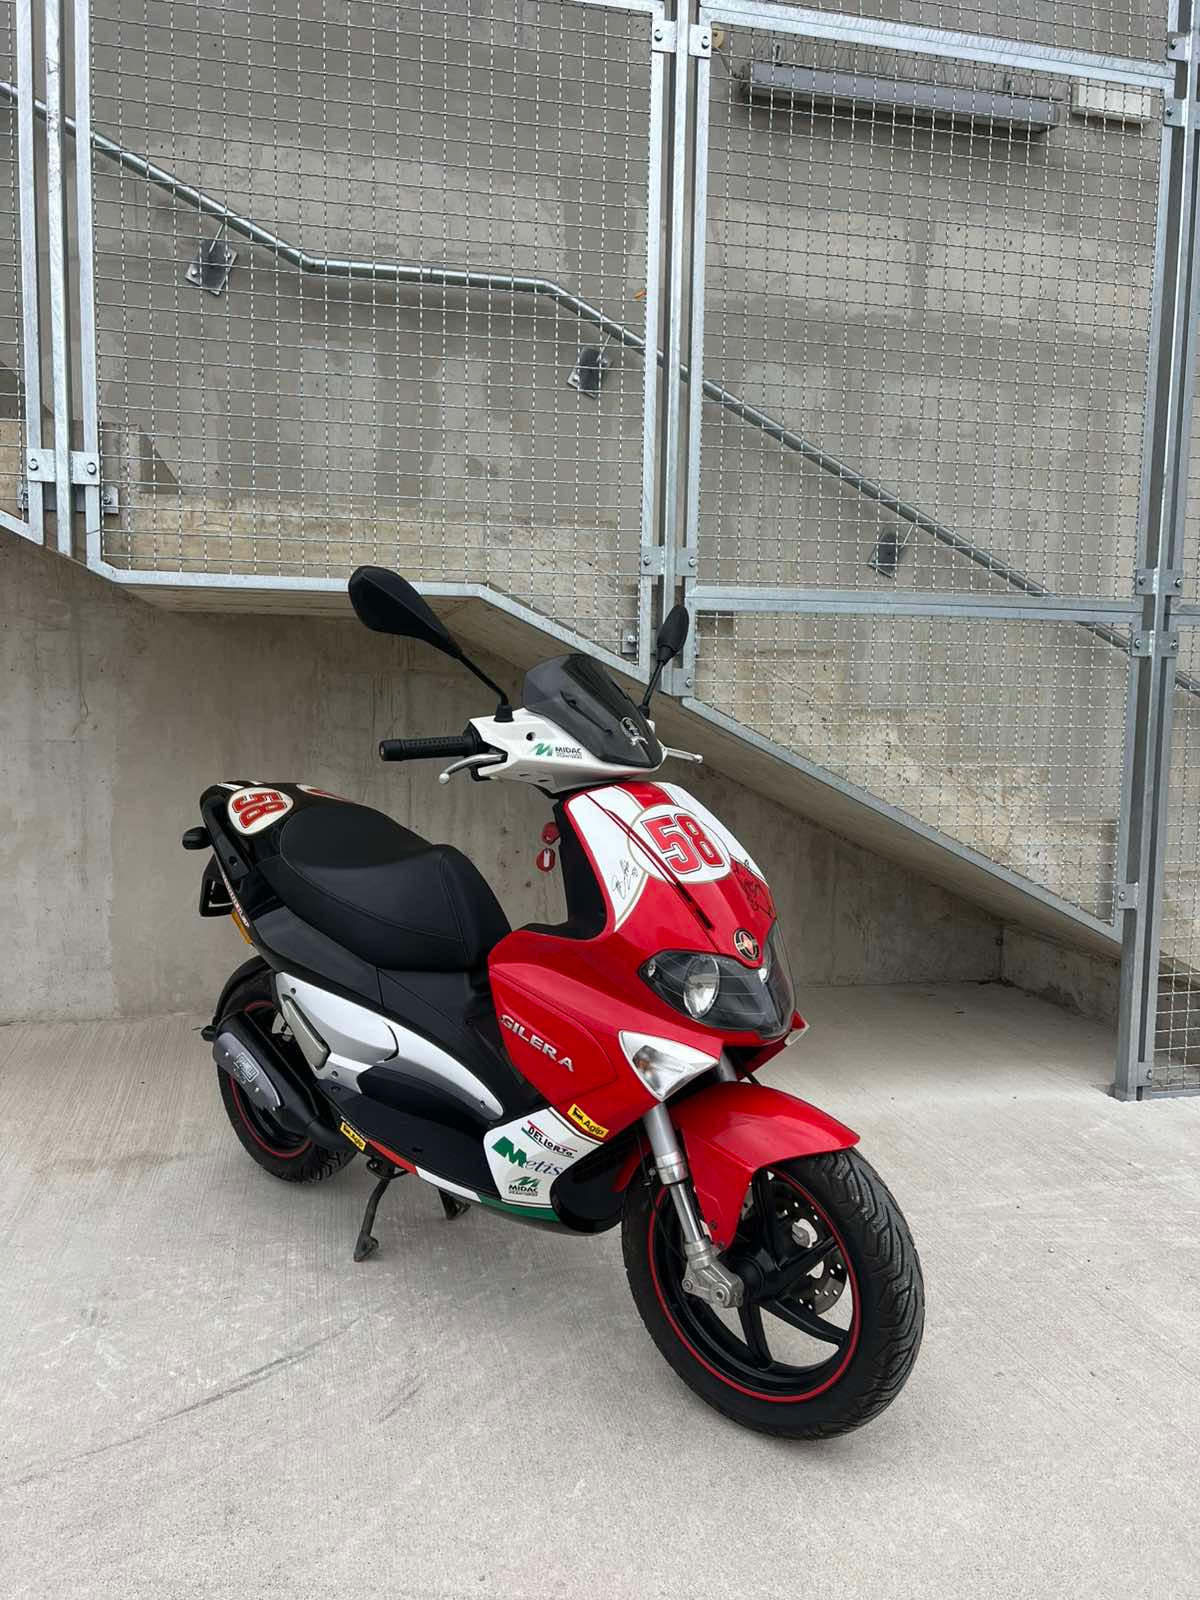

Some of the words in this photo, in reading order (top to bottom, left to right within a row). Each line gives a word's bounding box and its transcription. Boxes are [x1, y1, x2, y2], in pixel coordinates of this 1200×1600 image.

[232, 791, 288, 829] 58
[641, 813, 725, 875] 58
[498, 1014, 574, 1072] GILERA
[583, 1120, 604, 1136] Agip
